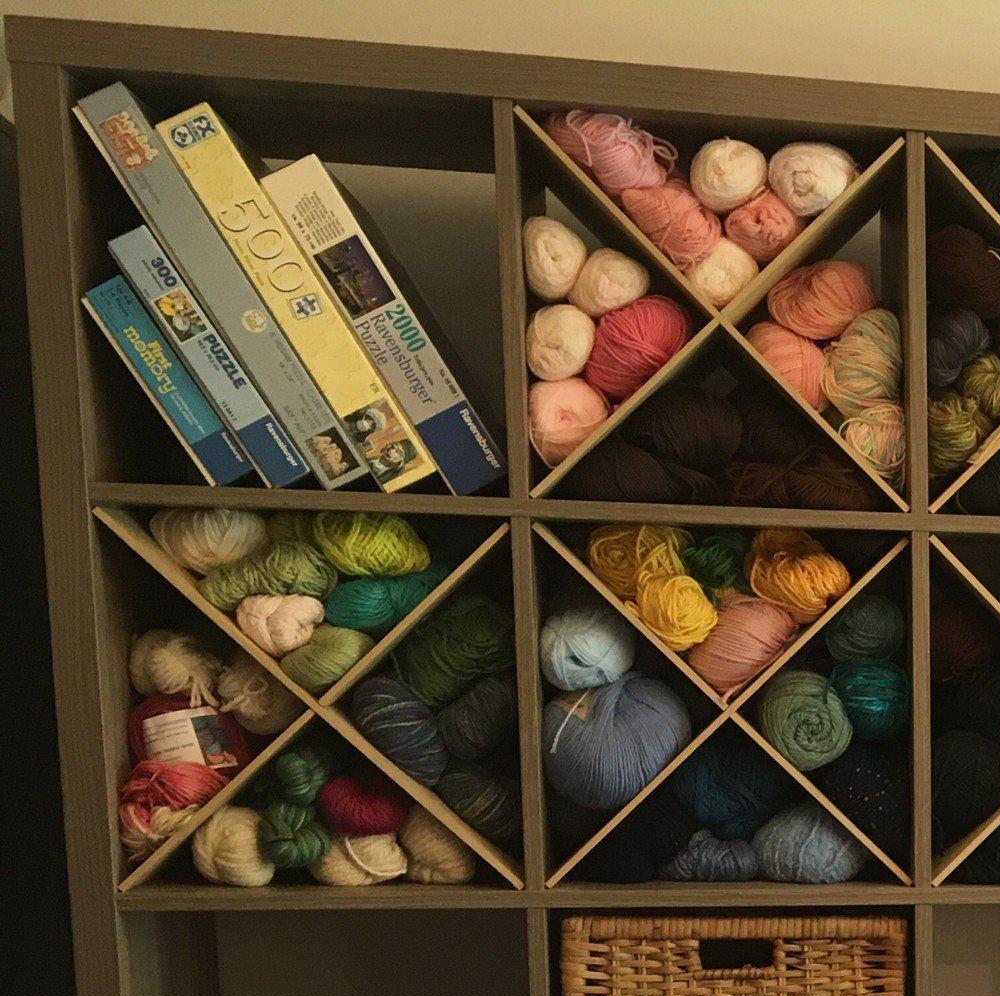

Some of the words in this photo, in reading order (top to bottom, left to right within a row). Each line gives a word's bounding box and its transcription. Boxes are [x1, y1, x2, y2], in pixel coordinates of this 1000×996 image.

[149, 254, 178, 290] 300
[217, 198, 305, 293] 500
[147, 339, 174, 371] First
[354, 319, 391, 367] Puzzle
[383, 300, 428, 355] 2000
[119, 323, 176, 396] memory
[201, 331, 246, 391] PUZZLE
[366, 312, 435, 409] Ravensburger
[263, 421, 298, 469] Ravensburger
[460, 407, 500, 470] Ravensburger
